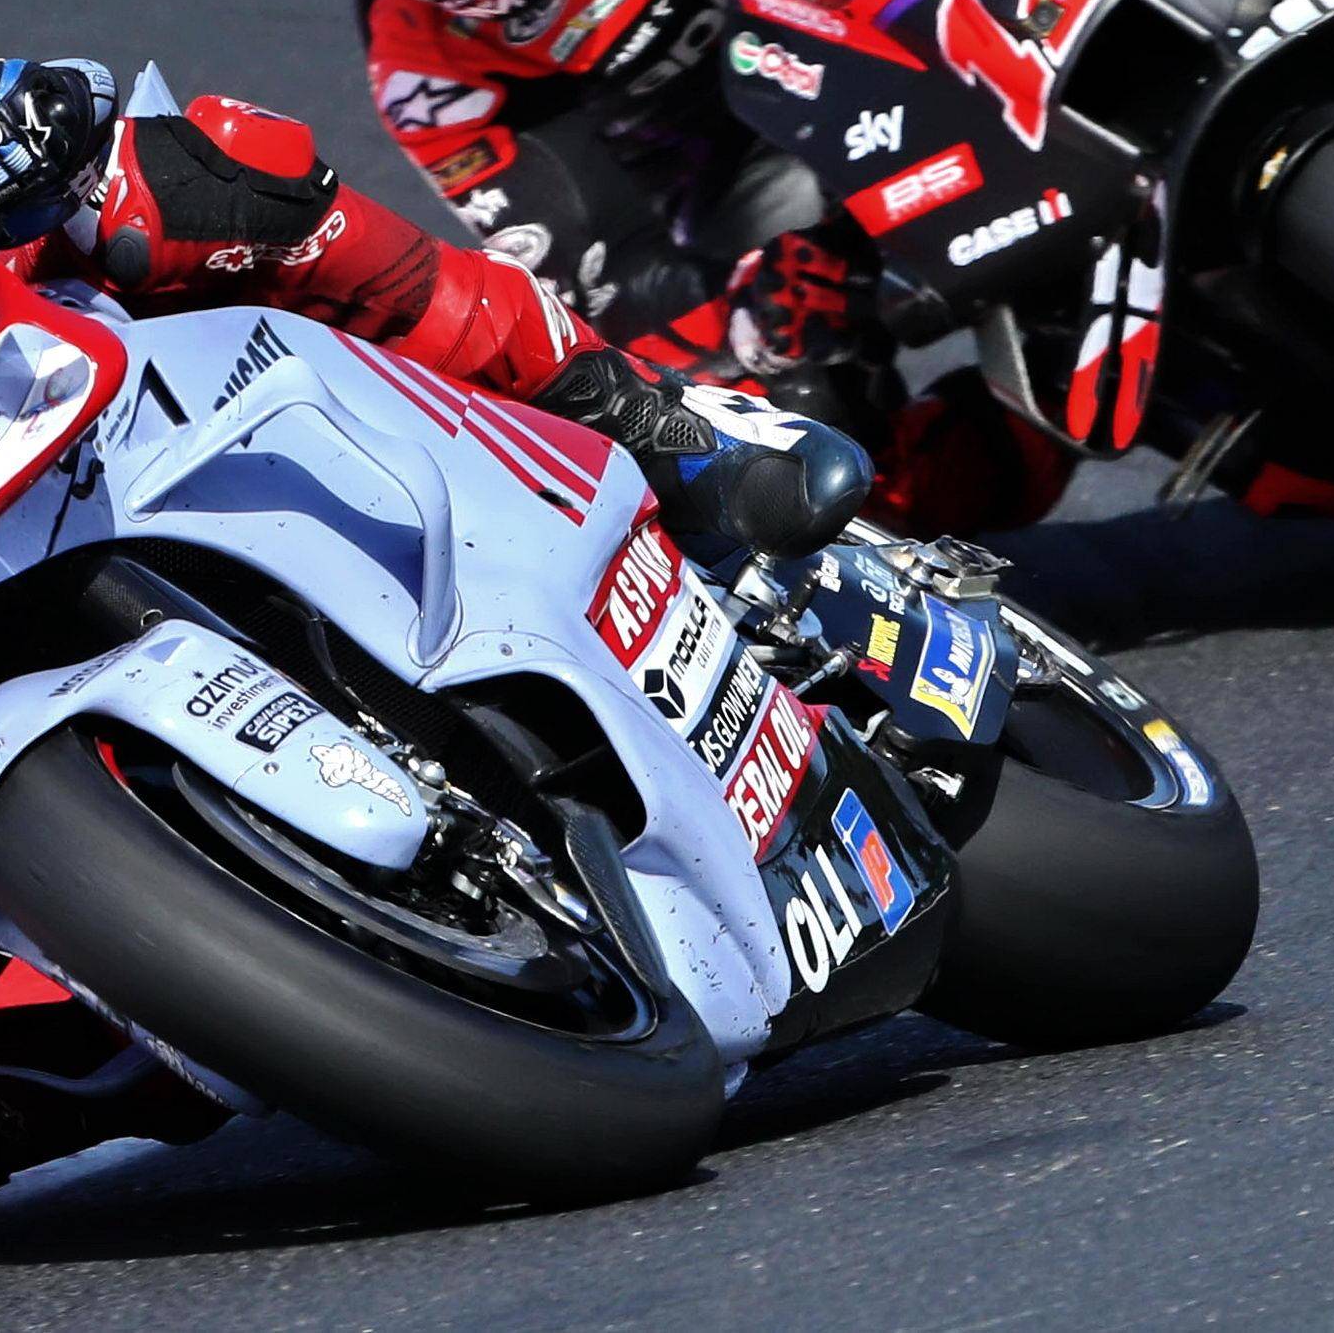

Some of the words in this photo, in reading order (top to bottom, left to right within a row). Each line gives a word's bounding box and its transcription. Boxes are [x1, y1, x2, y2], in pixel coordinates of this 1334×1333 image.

[844, 105, 905, 162] sky
[948, 207, 1040, 266] CASE
[186, 653, 267, 718] azimut
[256, 701, 319, 746] SIPEX
[727, 732, 793, 857] DERAL
[769, 689, 813, 770] OIL
[786, 843, 864, 994] OLI
